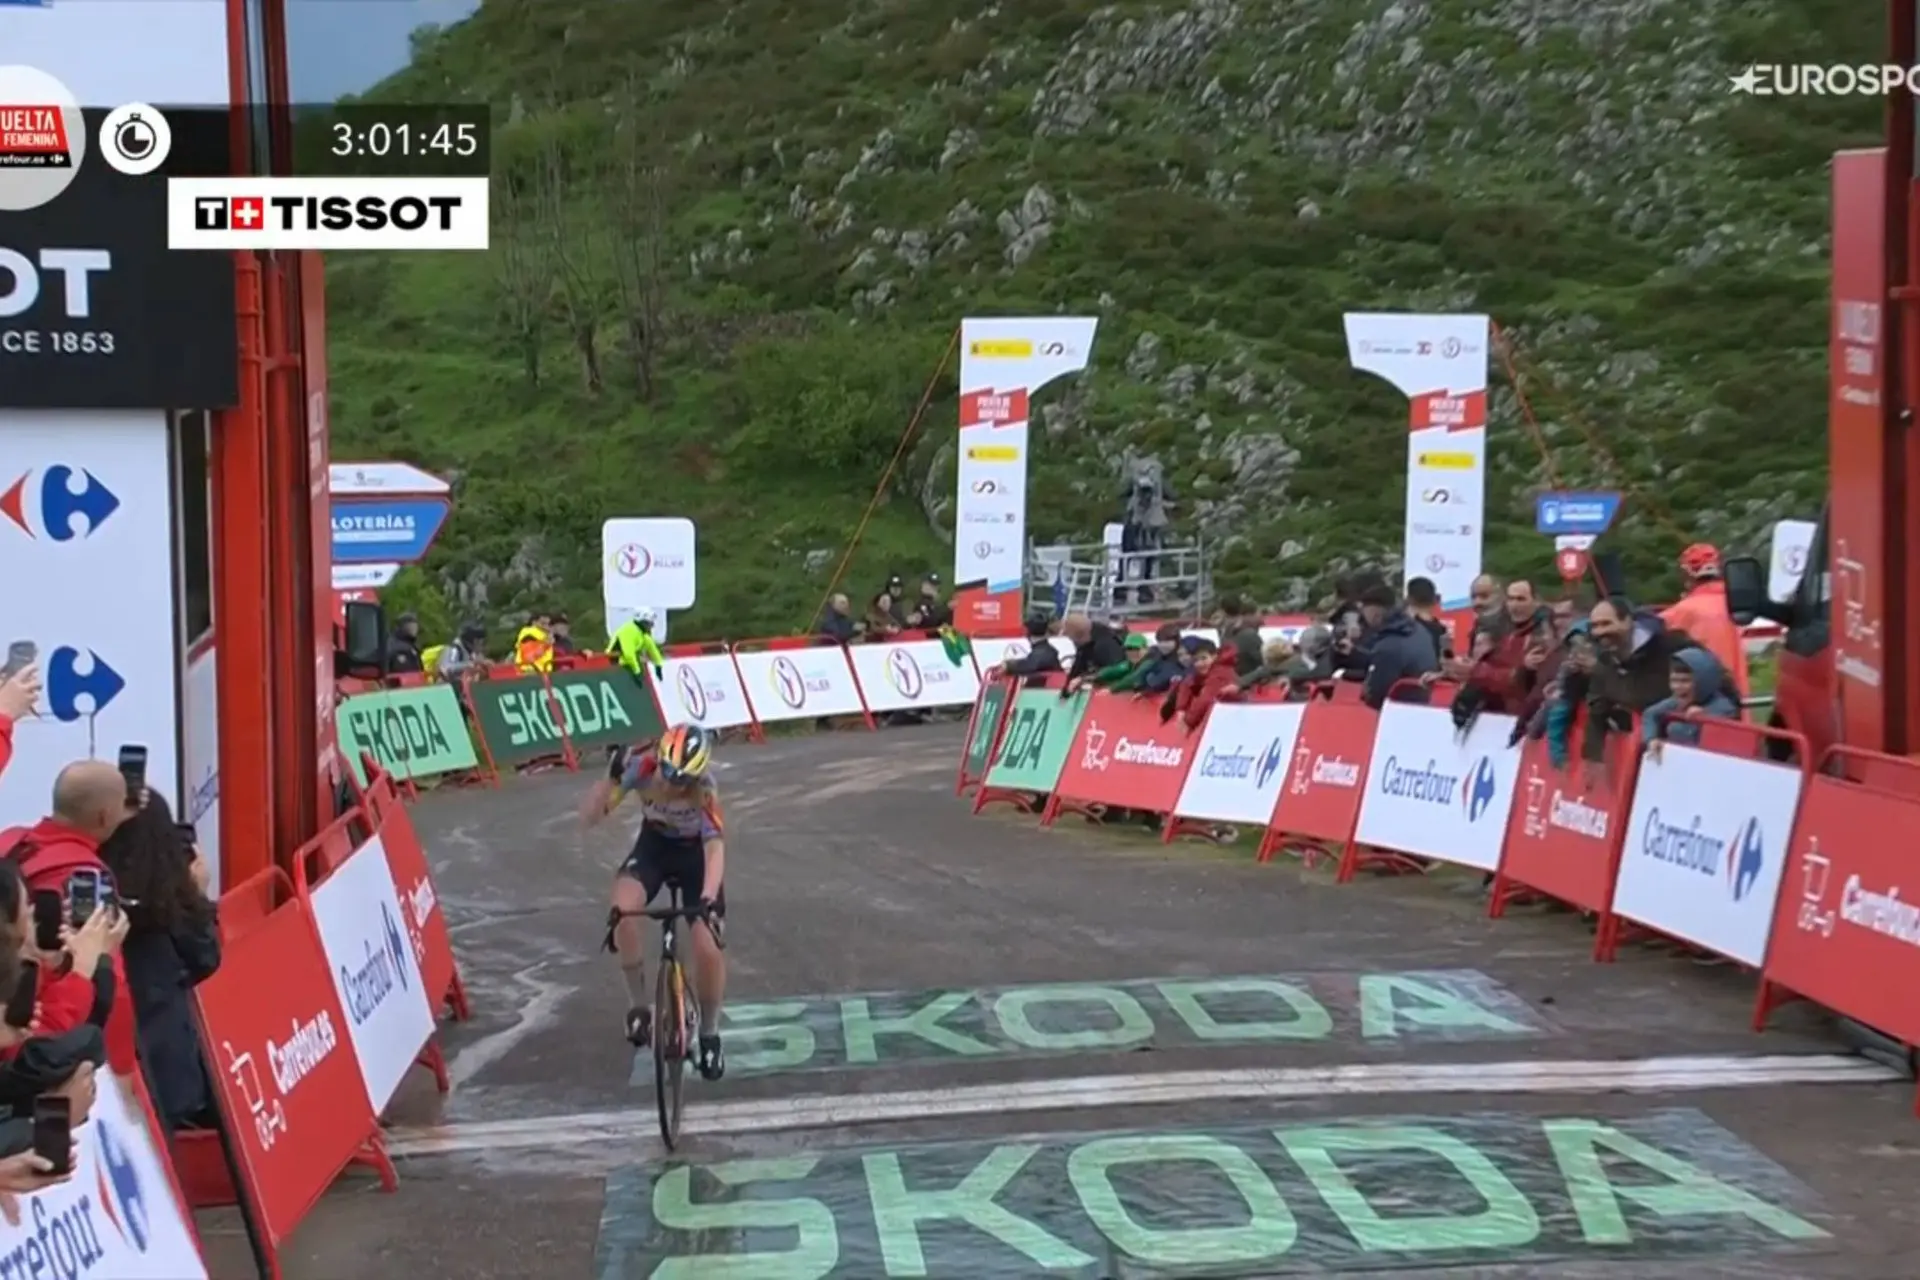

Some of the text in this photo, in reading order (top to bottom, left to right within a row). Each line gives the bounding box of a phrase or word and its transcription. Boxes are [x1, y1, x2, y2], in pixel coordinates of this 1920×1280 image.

[50, 331, 115, 354] 1853
[1381, 755, 1457, 805] Carrefour
[1642, 806, 1724, 876] Carrefour
